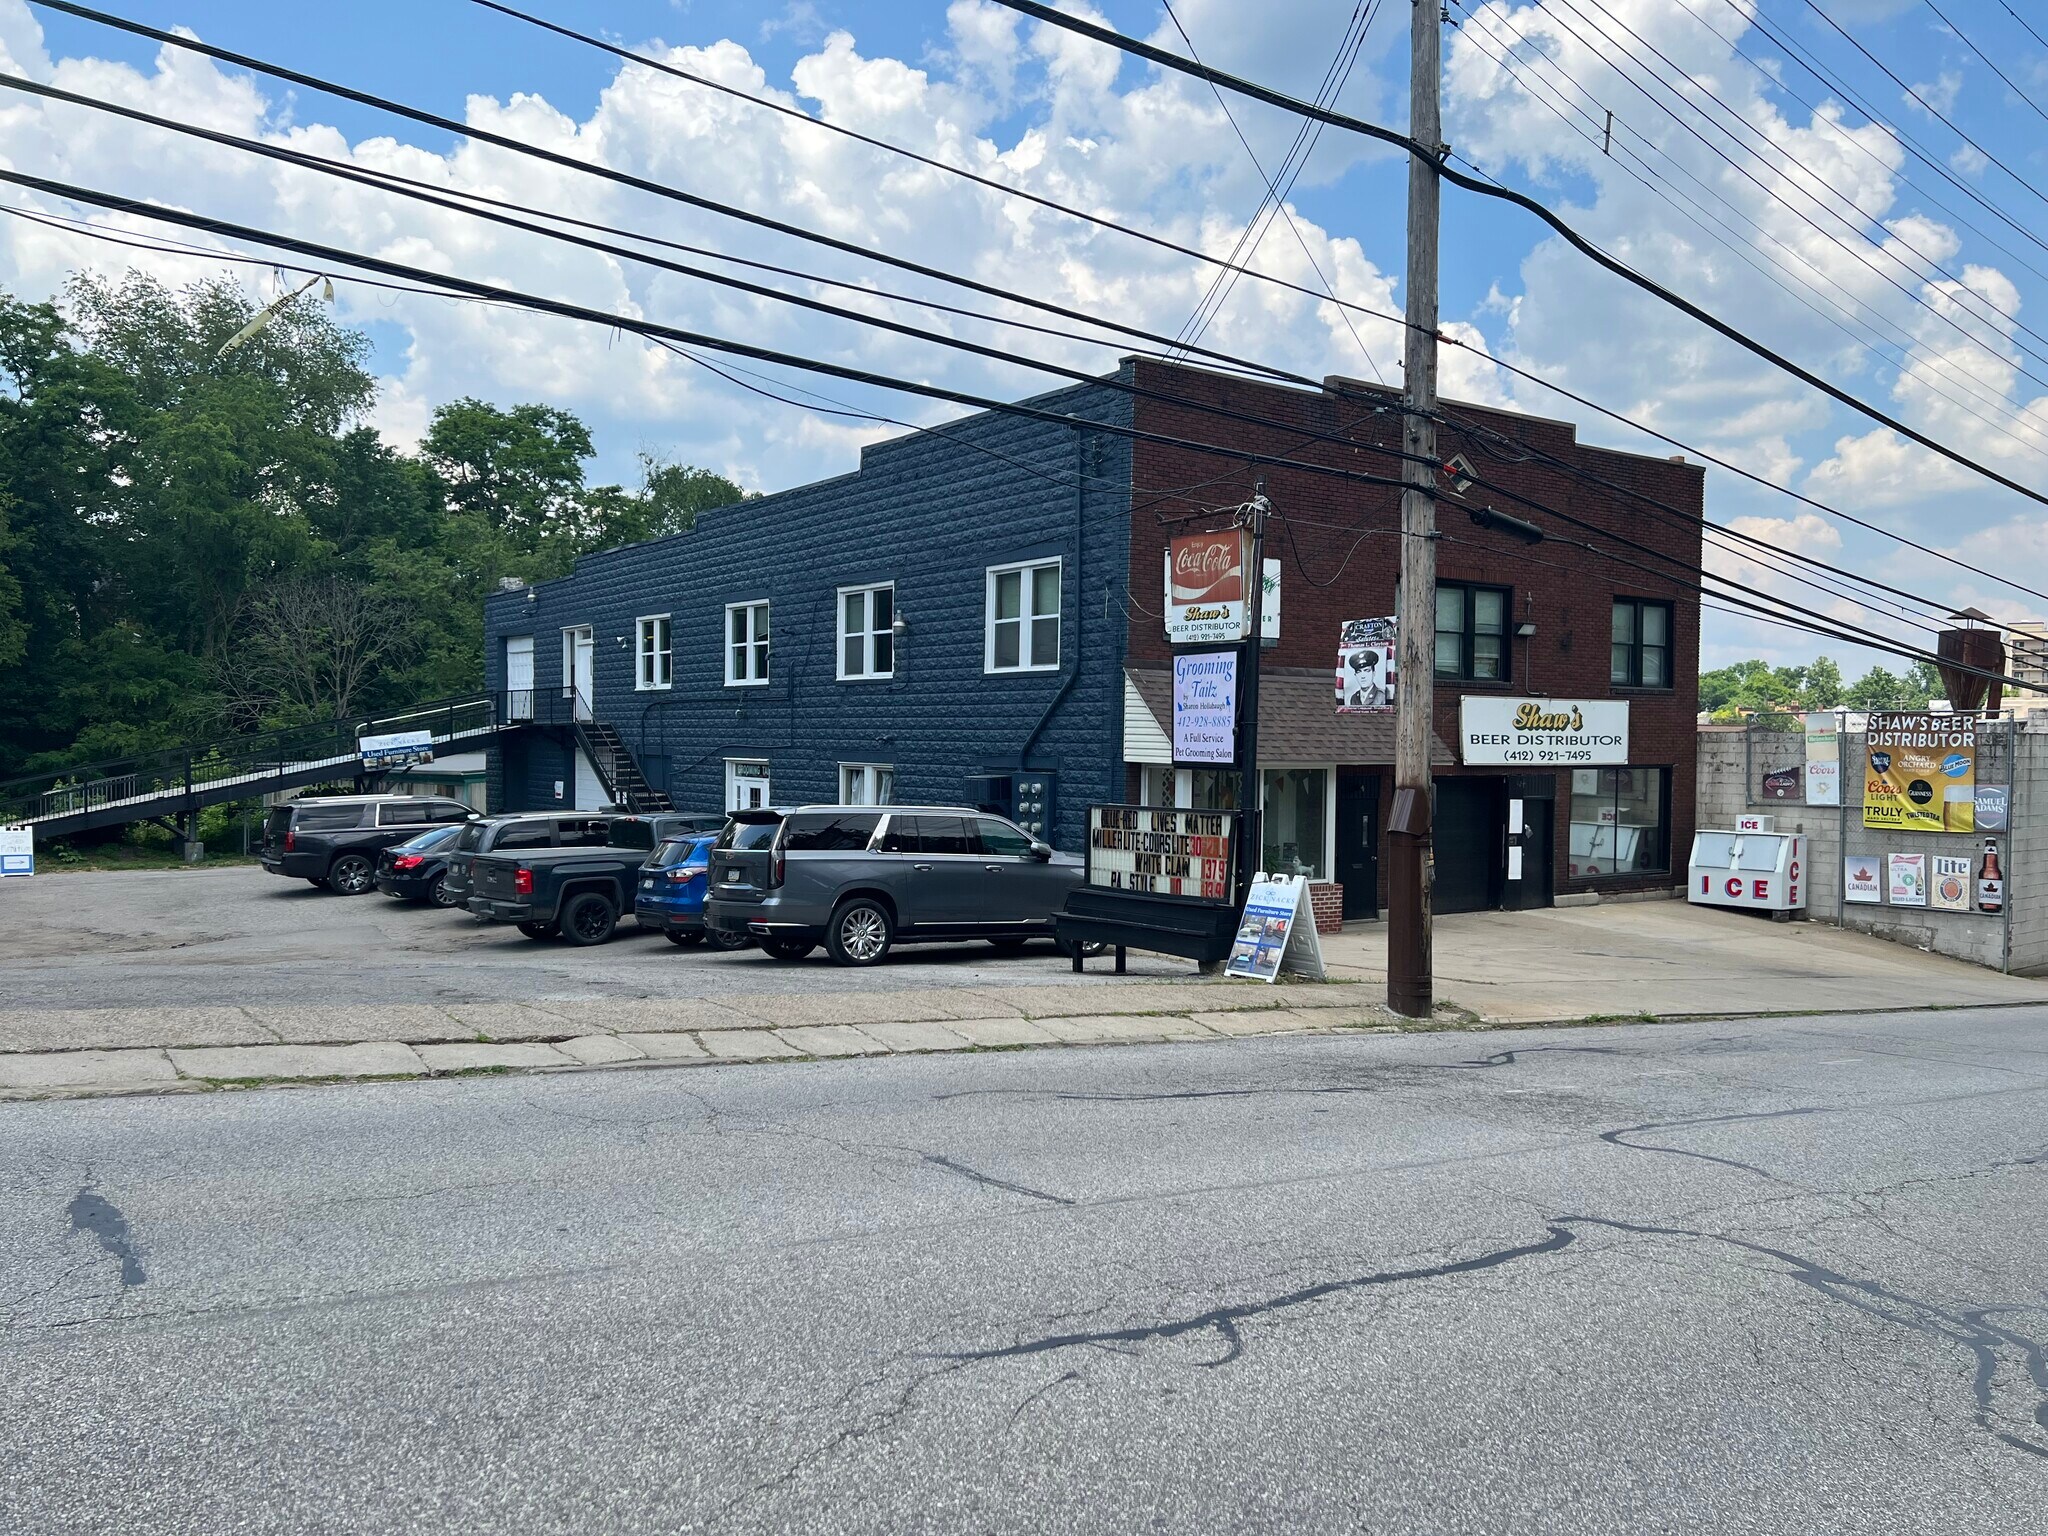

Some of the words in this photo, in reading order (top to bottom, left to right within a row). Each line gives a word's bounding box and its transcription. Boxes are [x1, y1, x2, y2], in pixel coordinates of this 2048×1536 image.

[1184, 605, 1230, 621] Shaw's
[1172, 624, 1189, 632] BEER
[1191, 622, 1241, 631] DISTRIBUTOR
[1186, 633, 1199, 641] (412)
[1176, 656, 1234, 684] Grooming
[1191, 680, 1217, 698] Tailz
[1177, 715, 1232, 727] 412-928-8885
[1512, 703, 1583, 731] Shaw's
[1868, 716, 1929, 731] SHAW'S
[1931, 716, 1974, 731] BEER
[1183, 733, 1189, 743] A
[1190, 733, 1201, 743] Full
[1202, 733, 1224, 743] Service
[1470, 734, 1511, 745] BEER
[1517, 734, 1622, 746] DISTRIBUTOR
[1867, 732, 1975, 747] DISTRIBUTOR
[384, 747, 412, 755] Furniture
[1175, 747, 1184, 757] Pet
[1185, 748, 1214, 760] Grooming
[1215, 748, 1232, 758] Salon
[1504, 750, 1534, 761] (412)
[1538, 750, 1592, 761] 921-7495
[1897, 761, 1936, 769] ORCHARD
[1954, 758, 1971, 767] MOON
[1809, 764, 1835, 775] Coors
[1868, 780, 1902, 794] Coors
[1865, 806, 1903, 817] TRULY
[1974, 805, 2003, 813] ADAMS
[1151, 811, 1177, 833] LIVES
[1185, 814, 1222, 836] MATTER
[1740, 821, 1758, 829] ICE
[1135, 853, 1162, 875] WHITE
[1165, 856, 1190, 877] CLAW
[1937, 859, 1967, 876] Lite
[1789, 838, 1799, 905] ICE
[1702, 876, 1768, 900] ICE
[1848, 883, 1878, 892] CANADIAN
